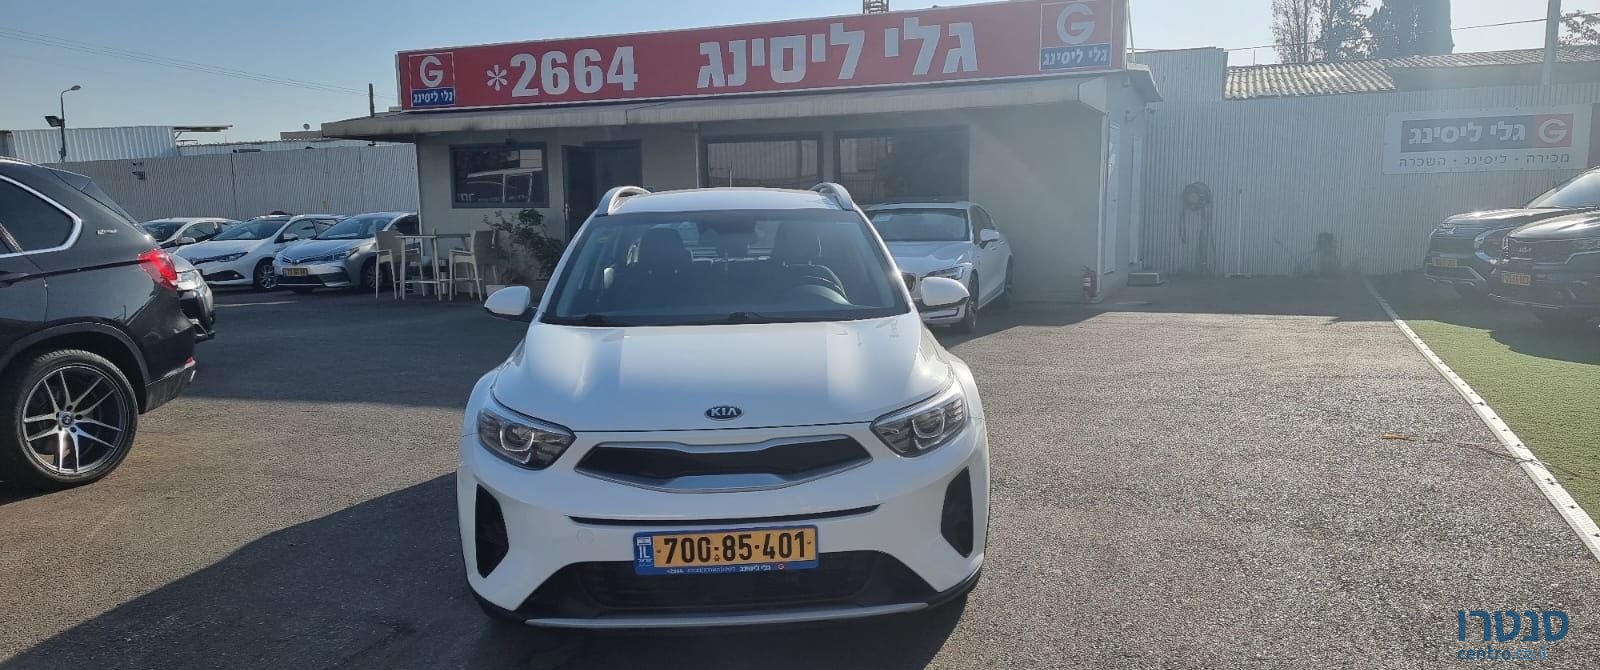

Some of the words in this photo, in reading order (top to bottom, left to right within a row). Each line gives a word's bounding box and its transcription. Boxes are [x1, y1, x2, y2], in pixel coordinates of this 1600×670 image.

[1057, 3, 1095, 45] G
[884, 17, 978, 76] גלי
[1088, 47, 1109, 62] גלי
[696, 23, 865, 89] ליסינג
[1043, 48, 1083, 66] ליסינג
[420, 55, 444, 88] G
[413, 91, 439, 104] ליסינג
[441, 90, 453, 102] גלי
[1408, 121, 1485, 145] ליסינג
[1490, 120, 1527, 142] גלי
[1538, 118, 1568, 144] G
[1399, 156, 1447, 169] השכרה
[1463, 153, 1508, 167] ליסינג
[1526, 152, 1570, 164] מכירה
[711, 407, 738, 417] KIA
[639, 545, 651, 559] IL
